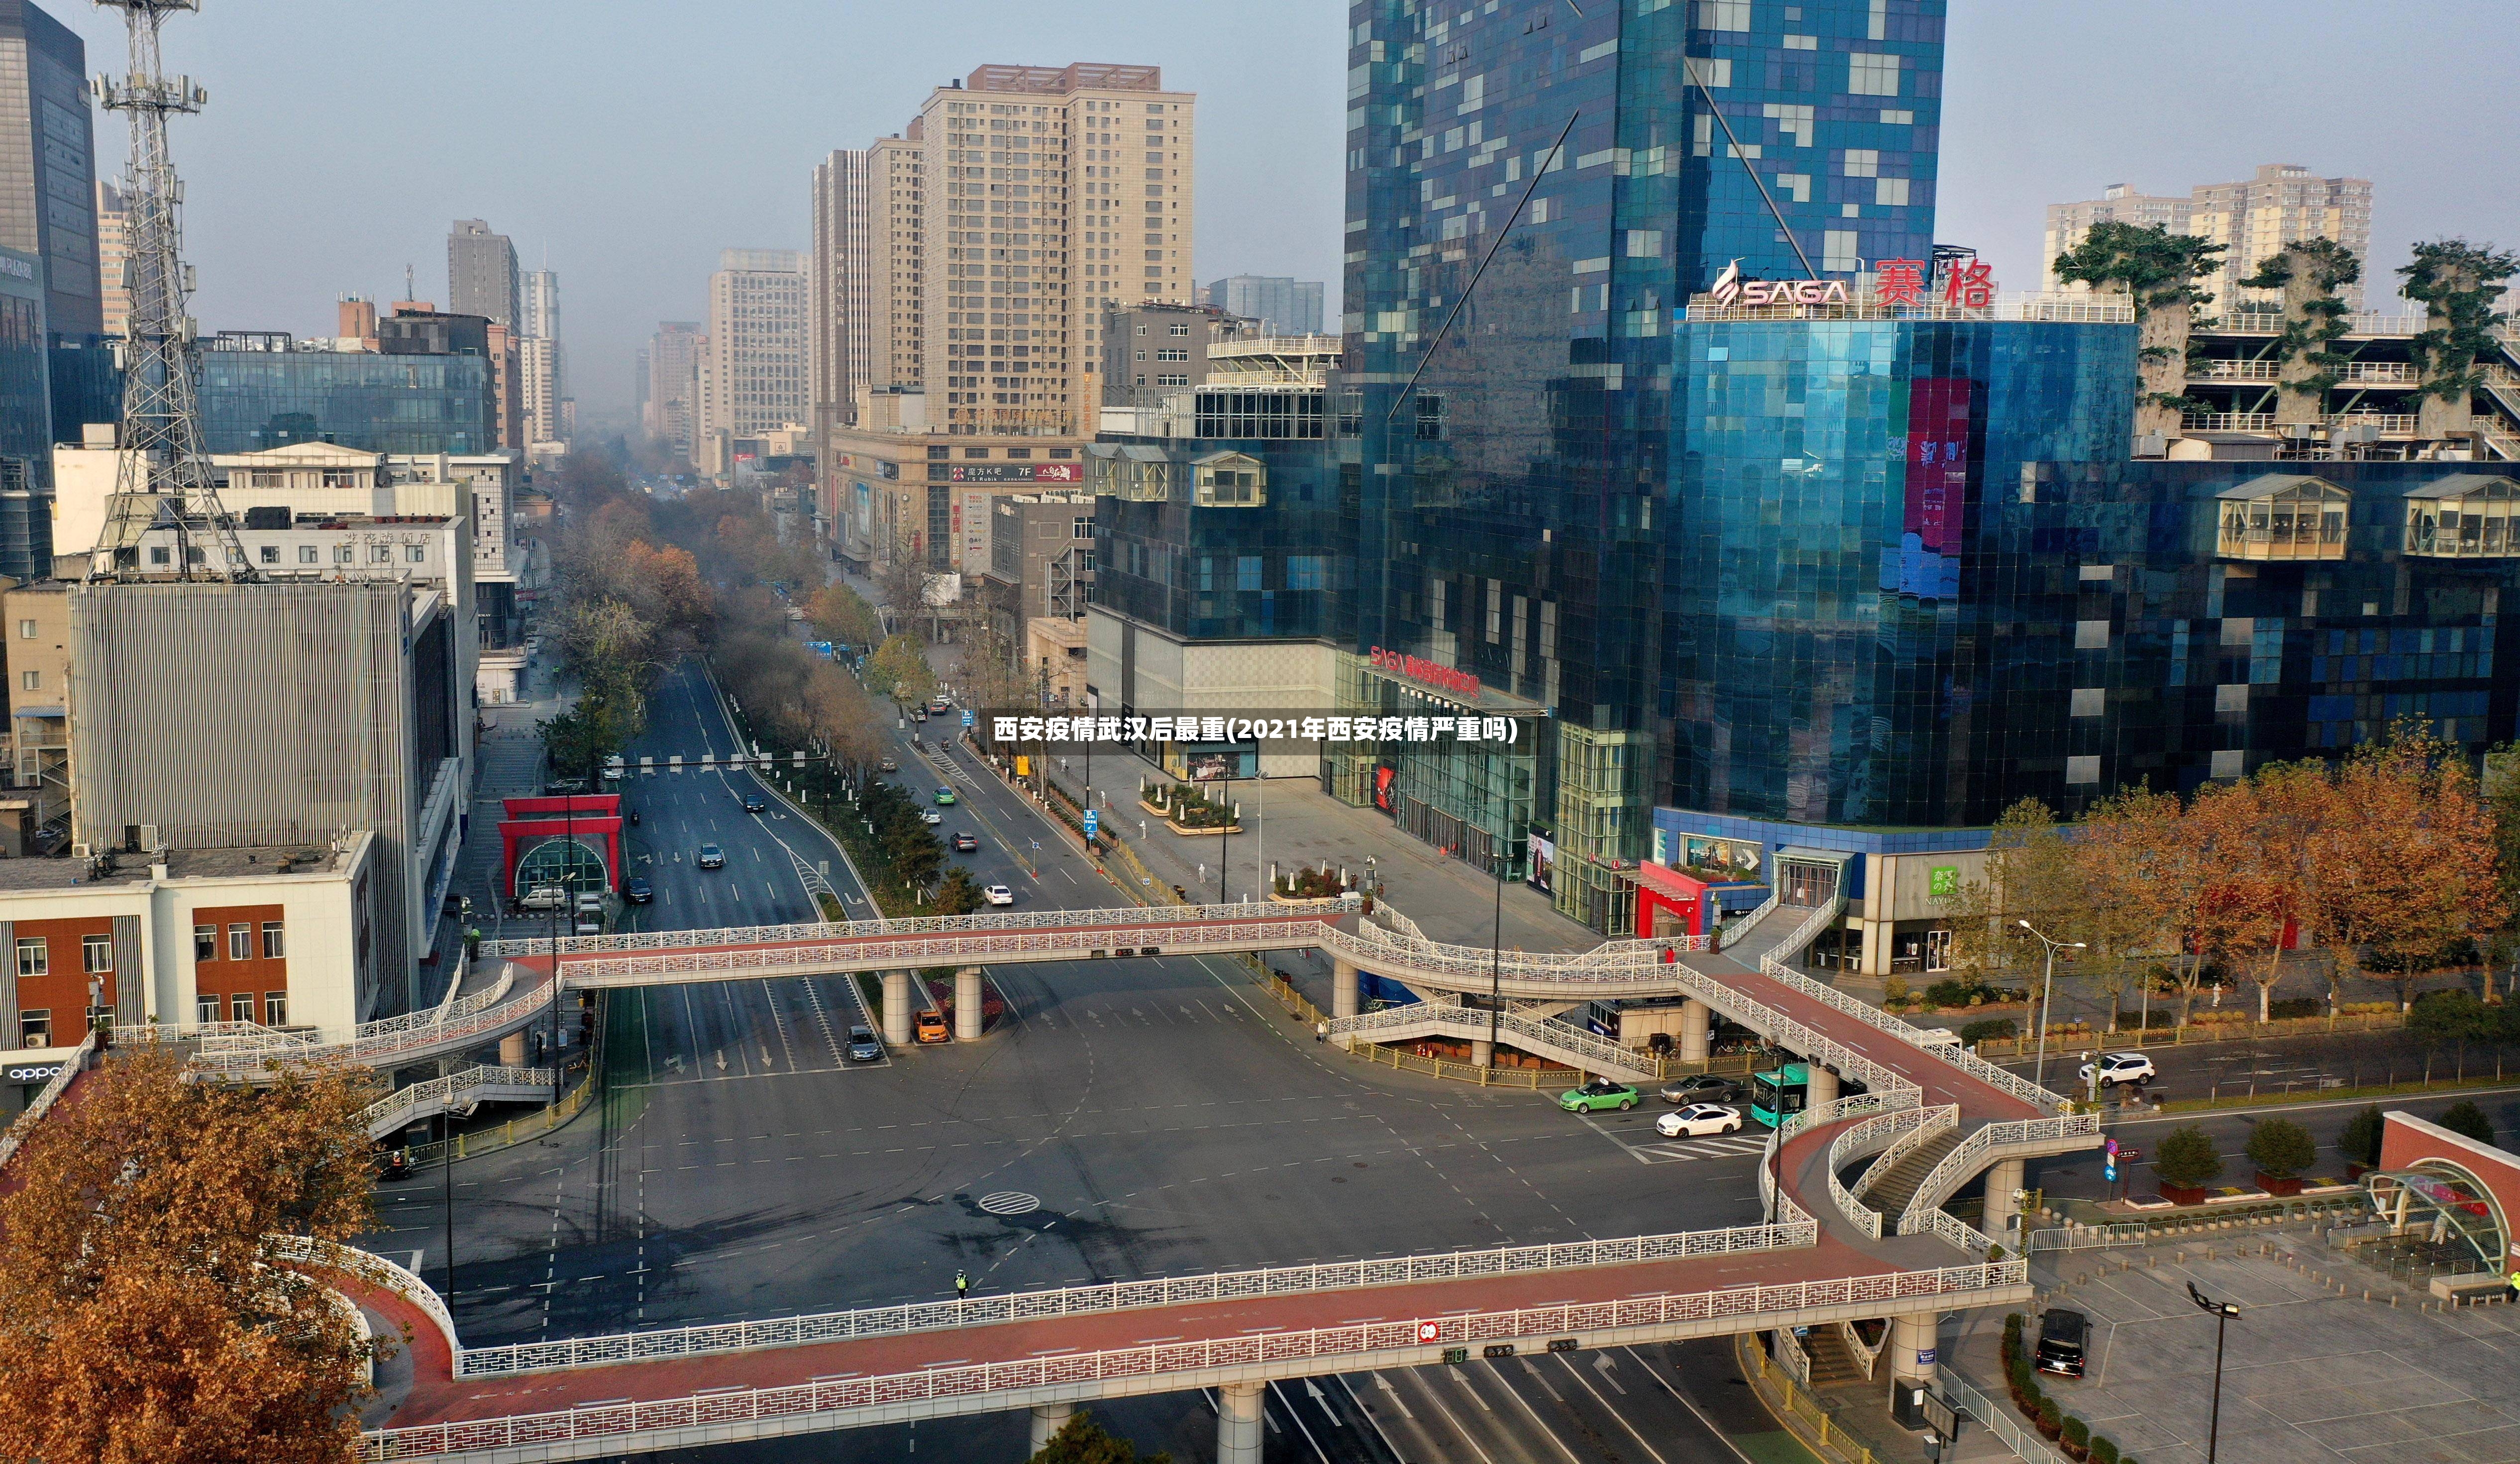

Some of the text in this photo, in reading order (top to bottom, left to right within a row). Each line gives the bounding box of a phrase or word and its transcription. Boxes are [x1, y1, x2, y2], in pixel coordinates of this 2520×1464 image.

[1743, 256, 1995, 309] SAGA 赛格
[1018, 468, 1031, 476] 7F
[1370, 645, 1405, 674] SAGA
[1924, 896, 1960, 905] NAYU
[10, 1067, 62, 1080] oppo
